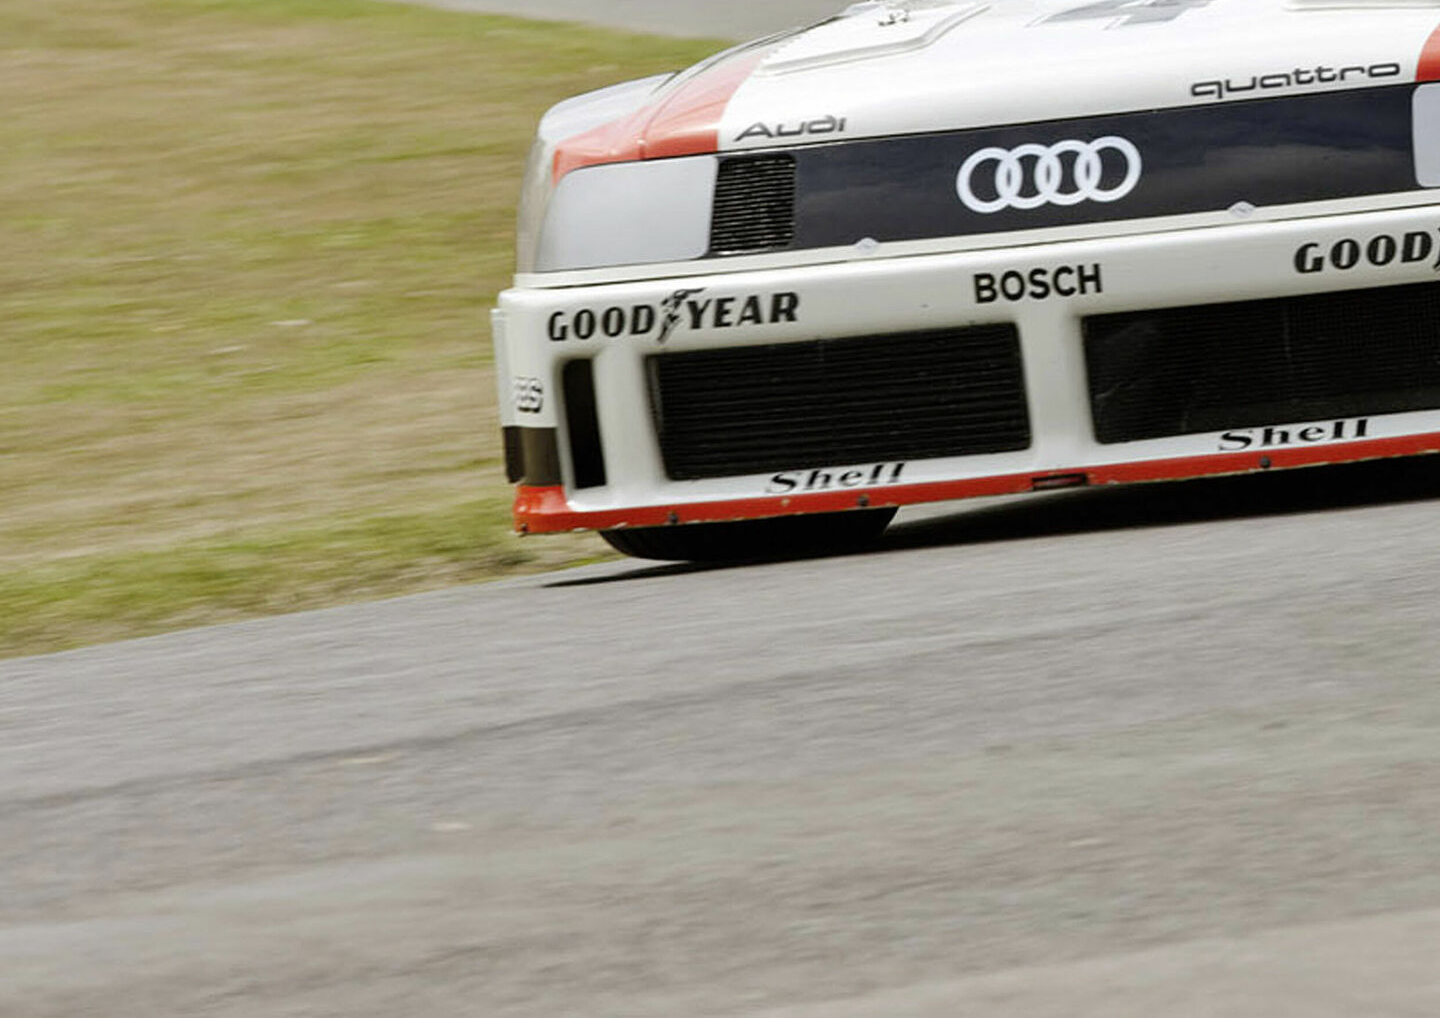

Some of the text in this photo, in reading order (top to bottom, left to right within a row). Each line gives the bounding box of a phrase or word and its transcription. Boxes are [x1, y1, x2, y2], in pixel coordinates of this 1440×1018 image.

[1190, 62, 1401, 99] quattro
[733, 114, 847, 142] Audi
[972, 263, 1103, 305] BOSCH
[1218, 418, 1368, 452] Shell
[765, 462, 906, 494] Shell
